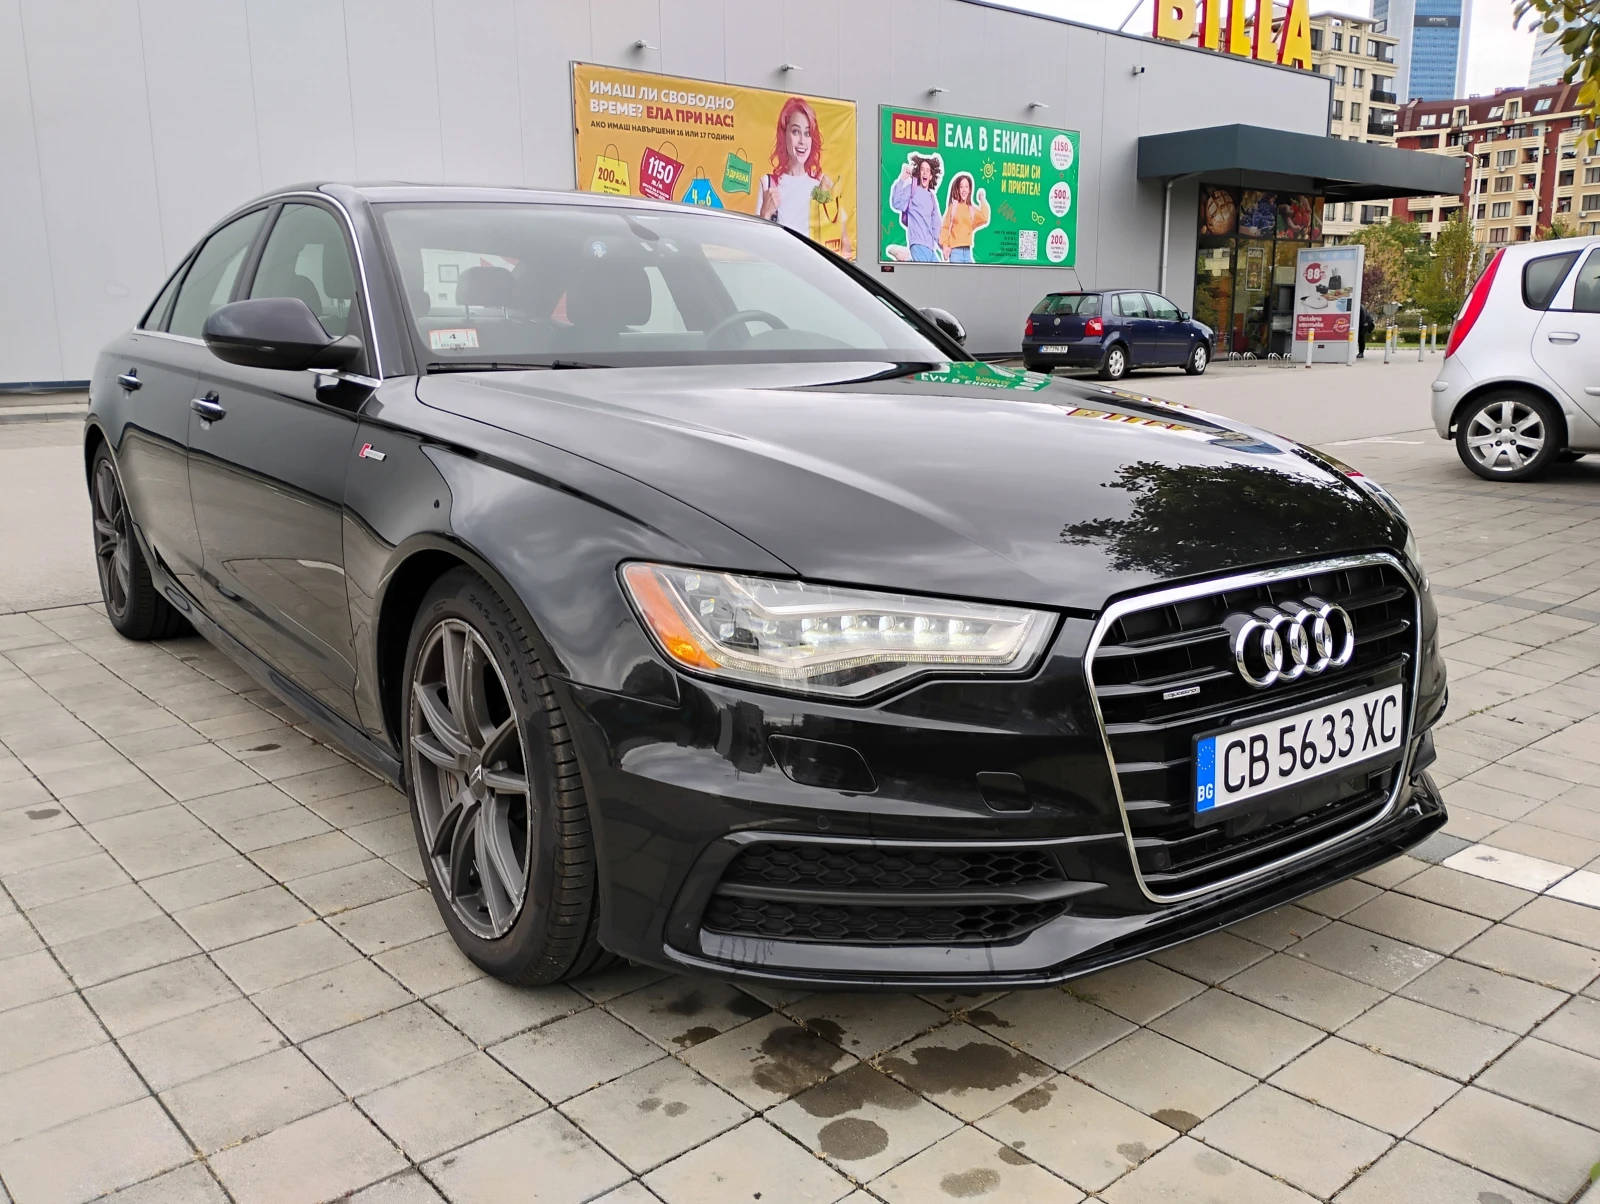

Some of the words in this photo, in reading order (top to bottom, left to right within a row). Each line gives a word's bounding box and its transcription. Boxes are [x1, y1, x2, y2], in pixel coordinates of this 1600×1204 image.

[589, 80, 636, 99] ИМАШ
[638, 86, 658, 101] ЛИ
[660, 89, 735, 111] СВОБОДНО
[590, 98, 643, 118] ВРЕМЕ?
[646, 105, 673, 122] ЕЛА
[675, 109, 703, 124] ПРИ
[705, 112, 735, 128] НАС!
[590, 120, 606, 128] АКО
[607, 121, 631, 131] ИМАШ
[631, 124, 676, 136] НАВЪРШЕНИ
[676, 129, 684, 137] 16
[684, 130, 699, 138] ИЛИ
[700, 131, 707, 139] 17
[707, 132, 735, 141] ГОДИНИ
[894, 118, 936, 143] BILLA
[945, 122, 974, 150] ЕЛА
[978, 126, 988, 151] В
[993, 129, 1043, 157] ЕКИПА!
[1054, 141, 1069, 152] 1150
[598, 167, 615, 183] 200
[648, 157, 674, 184] 1150
[1002, 162, 1029, 178] ДОВЕДИ
[1031, 164, 1041, 179] СИ
[692, 189, 698, 205] 4
[706, 190, 712, 206] 6
[1001, 179, 1006, 193] И
[1008, 180, 1041, 196] ПРИЯТЕЛ!
[1054, 189, 1067, 200] 500
[1051, 235, 1063, 244] 200
[468, 594, 512, 657] 245/45
[509, 659, 528, 705] R19
[1223, 733, 1270, 794] CB
[1278, 707, 1355, 777] 5633
[1361, 694, 1397, 751] XC
[1197, 783, 1214, 802] BG
